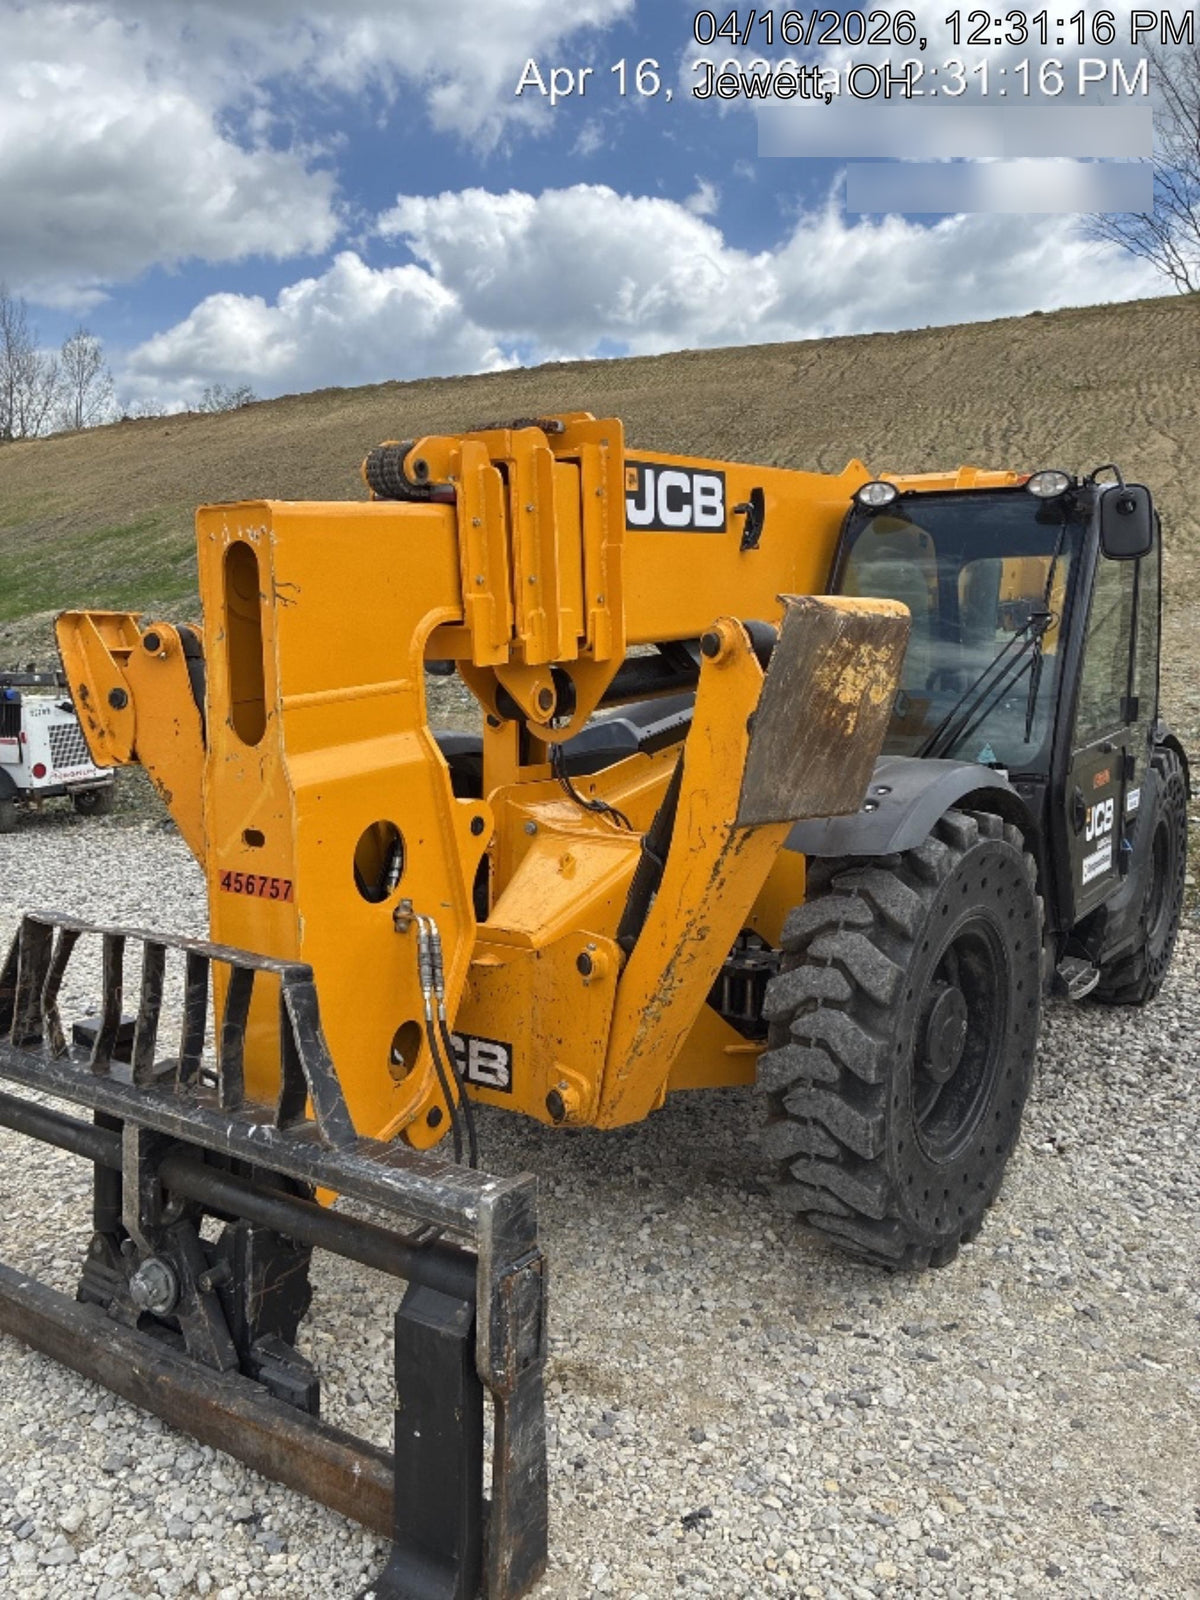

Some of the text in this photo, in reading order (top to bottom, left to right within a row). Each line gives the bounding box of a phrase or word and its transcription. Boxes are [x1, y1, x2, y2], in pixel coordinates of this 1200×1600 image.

[625, 468, 725, 528] JCB
[1085, 798, 1114, 842] JCB
[221, 871, 292, 900] 456757
